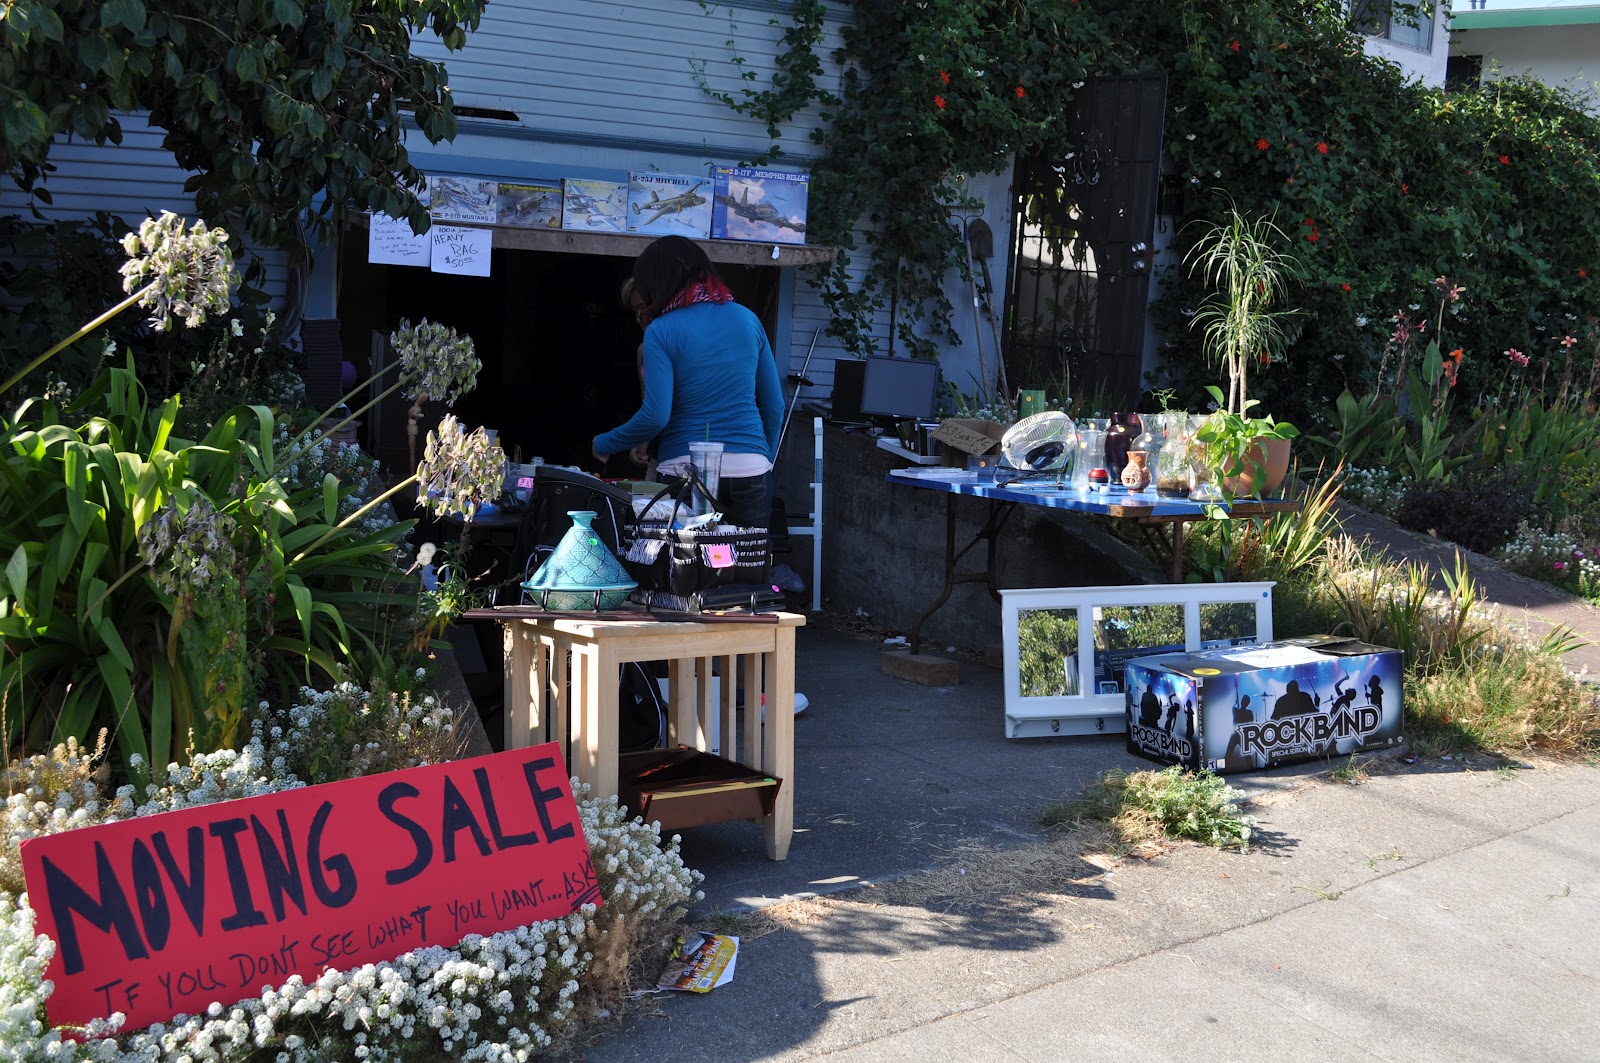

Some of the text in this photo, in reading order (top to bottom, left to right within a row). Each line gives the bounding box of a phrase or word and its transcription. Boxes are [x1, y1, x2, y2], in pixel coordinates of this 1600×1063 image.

[734, 169, 751, 177] B-17F
[632, 175, 689, 186] B-25J MITCHELL
[434, 233, 464, 245] HEAVY
[450, 243, 478, 257] BAG
[938, 423, 958, 436] PS3
[1271, 746, 1309, 758] SPECIAL EDITION
[42, 757, 575, 976] MOVING SALE
[94, 978, 140, 1015] IF
[158, 964, 226, 1009] YOU
[310, 930, 360, 967] SEE
[367, 905, 432, 950] WHAT
[446, 898, 488, 932] YOU
[683, 971, 702, 990] STEAM
[695, 956, 713, 973] TABLE
[706, 939, 722, 956] PANS
